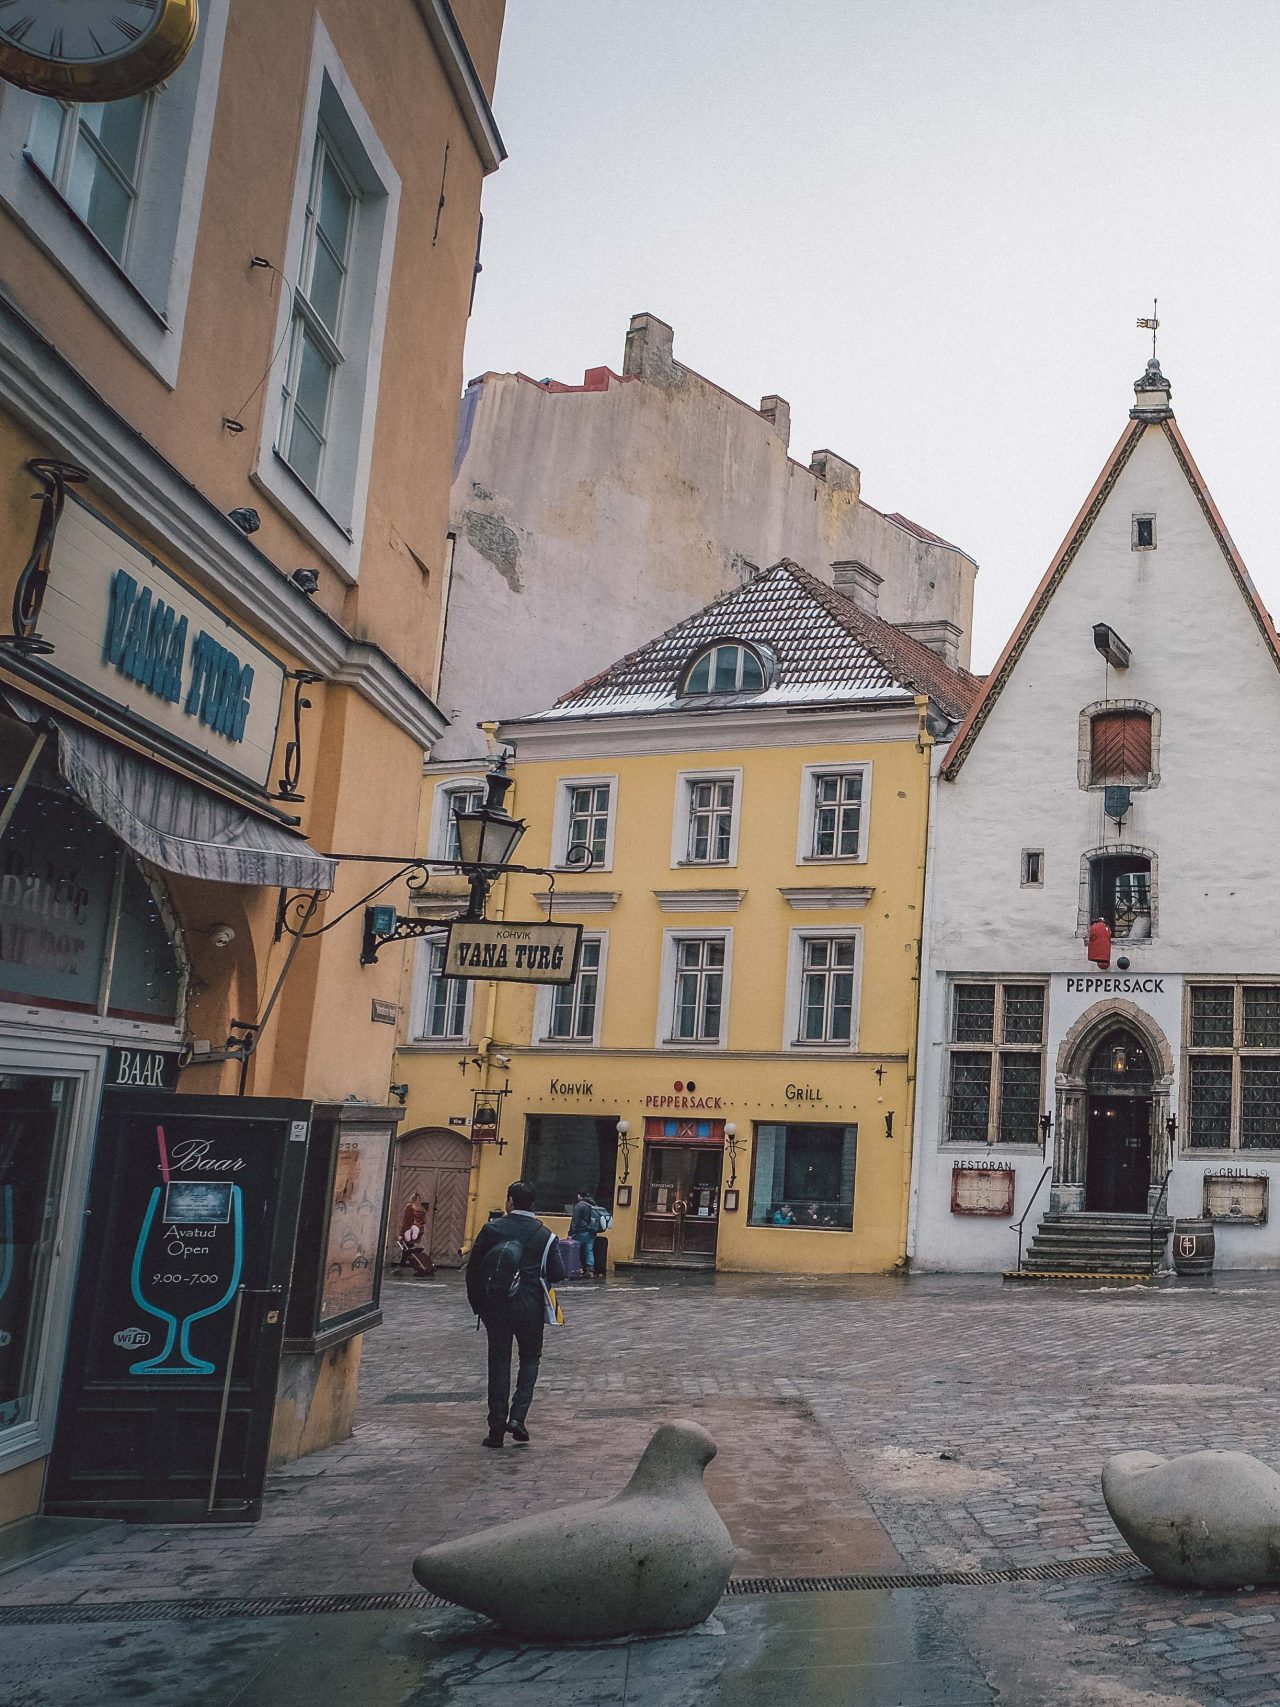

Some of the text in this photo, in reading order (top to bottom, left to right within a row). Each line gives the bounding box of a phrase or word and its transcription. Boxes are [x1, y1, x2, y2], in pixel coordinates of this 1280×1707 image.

[108, 569, 255, 743] VANA TURG
[496, 930, 532, 940] KOHVIK
[458, 943, 564, 970] VANA TURG
[1066, 977, 1165, 993] PEPPERSACK
[116, 1051, 165, 1087] BAAR
[645, 1095, 722, 1109] PEPPERSACK
[157, 1138, 247, 1172] Baar
[953, 1159, 1013, 1171] RESTORAN
[1219, 1167, 1251, 1177] GRILL
[163, 1225, 217, 1239] Avatud
[168, 1240, 209, 1259] Open
